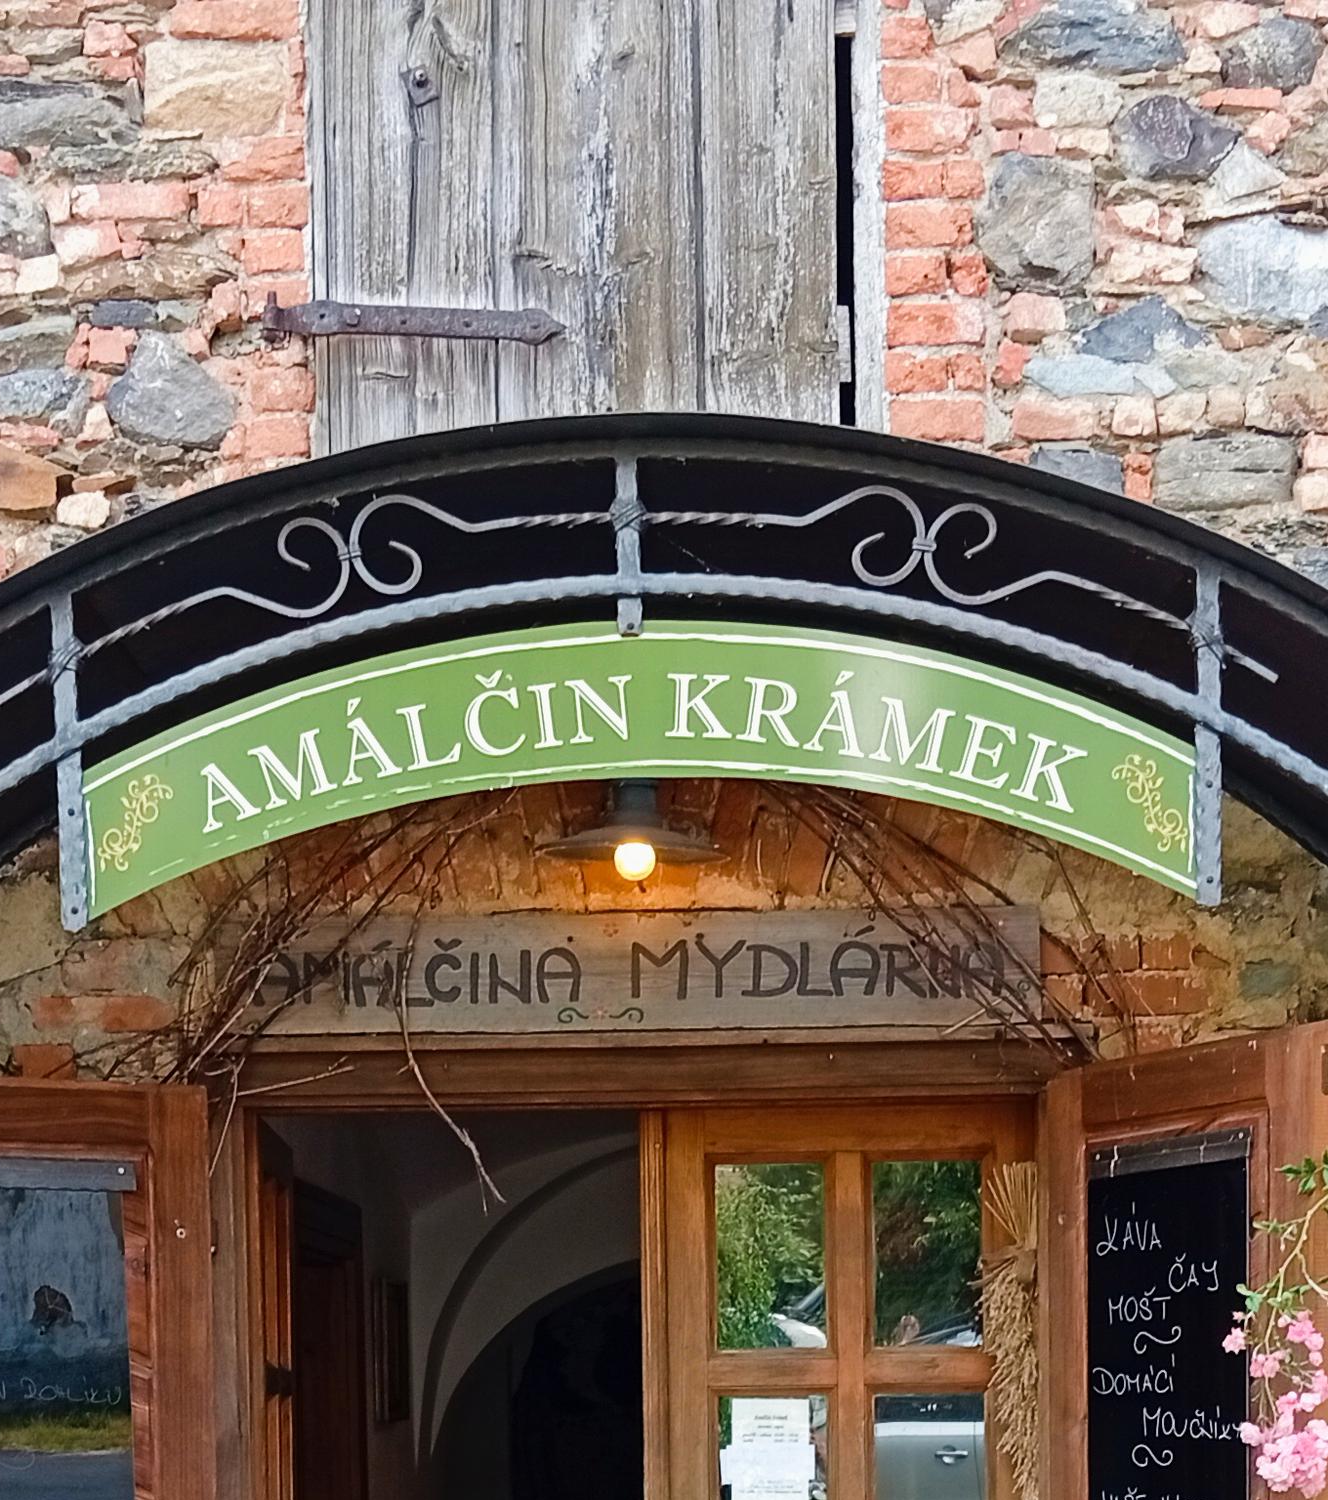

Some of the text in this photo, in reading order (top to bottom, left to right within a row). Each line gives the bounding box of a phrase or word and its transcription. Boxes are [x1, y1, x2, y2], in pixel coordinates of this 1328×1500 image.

[200, 669, 1089, 835] AMÁLČIN KRÁMEK
[253, 937, 582, 1008] AMÁLČINA
[1096, 1201, 1162, 1257] KÁVA
[1108, 1286, 1171, 1325] MOŠT
[1092, 1353, 1175, 1396] DOMÁCÍ
